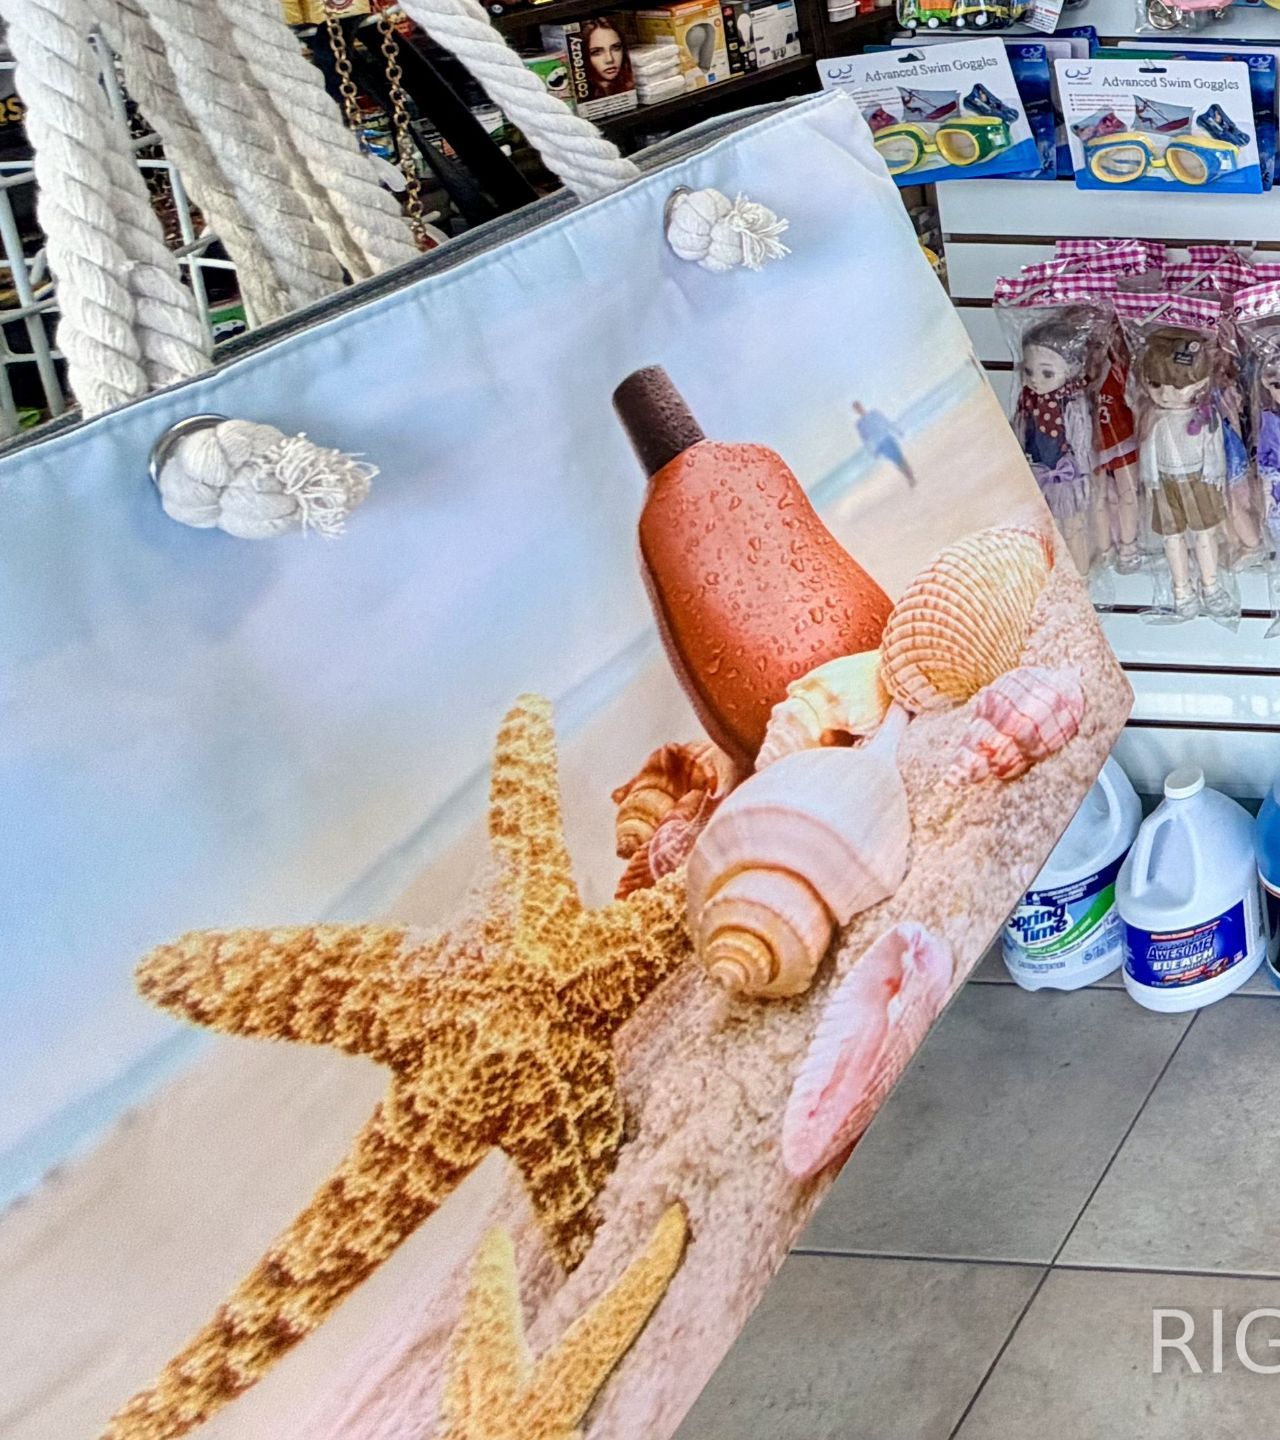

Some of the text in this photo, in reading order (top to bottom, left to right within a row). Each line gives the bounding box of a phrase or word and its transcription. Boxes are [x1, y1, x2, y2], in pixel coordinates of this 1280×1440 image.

[569, 36, 589, 99] coloreazy
[864, 56, 998, 83] Advanced Swim Goggles
[1102, 75, 1240, 92] Advanced Swim Goggles
[1021, 918, 1067, 943] Time
[1152, 948, 1214, 972] BLEACH
